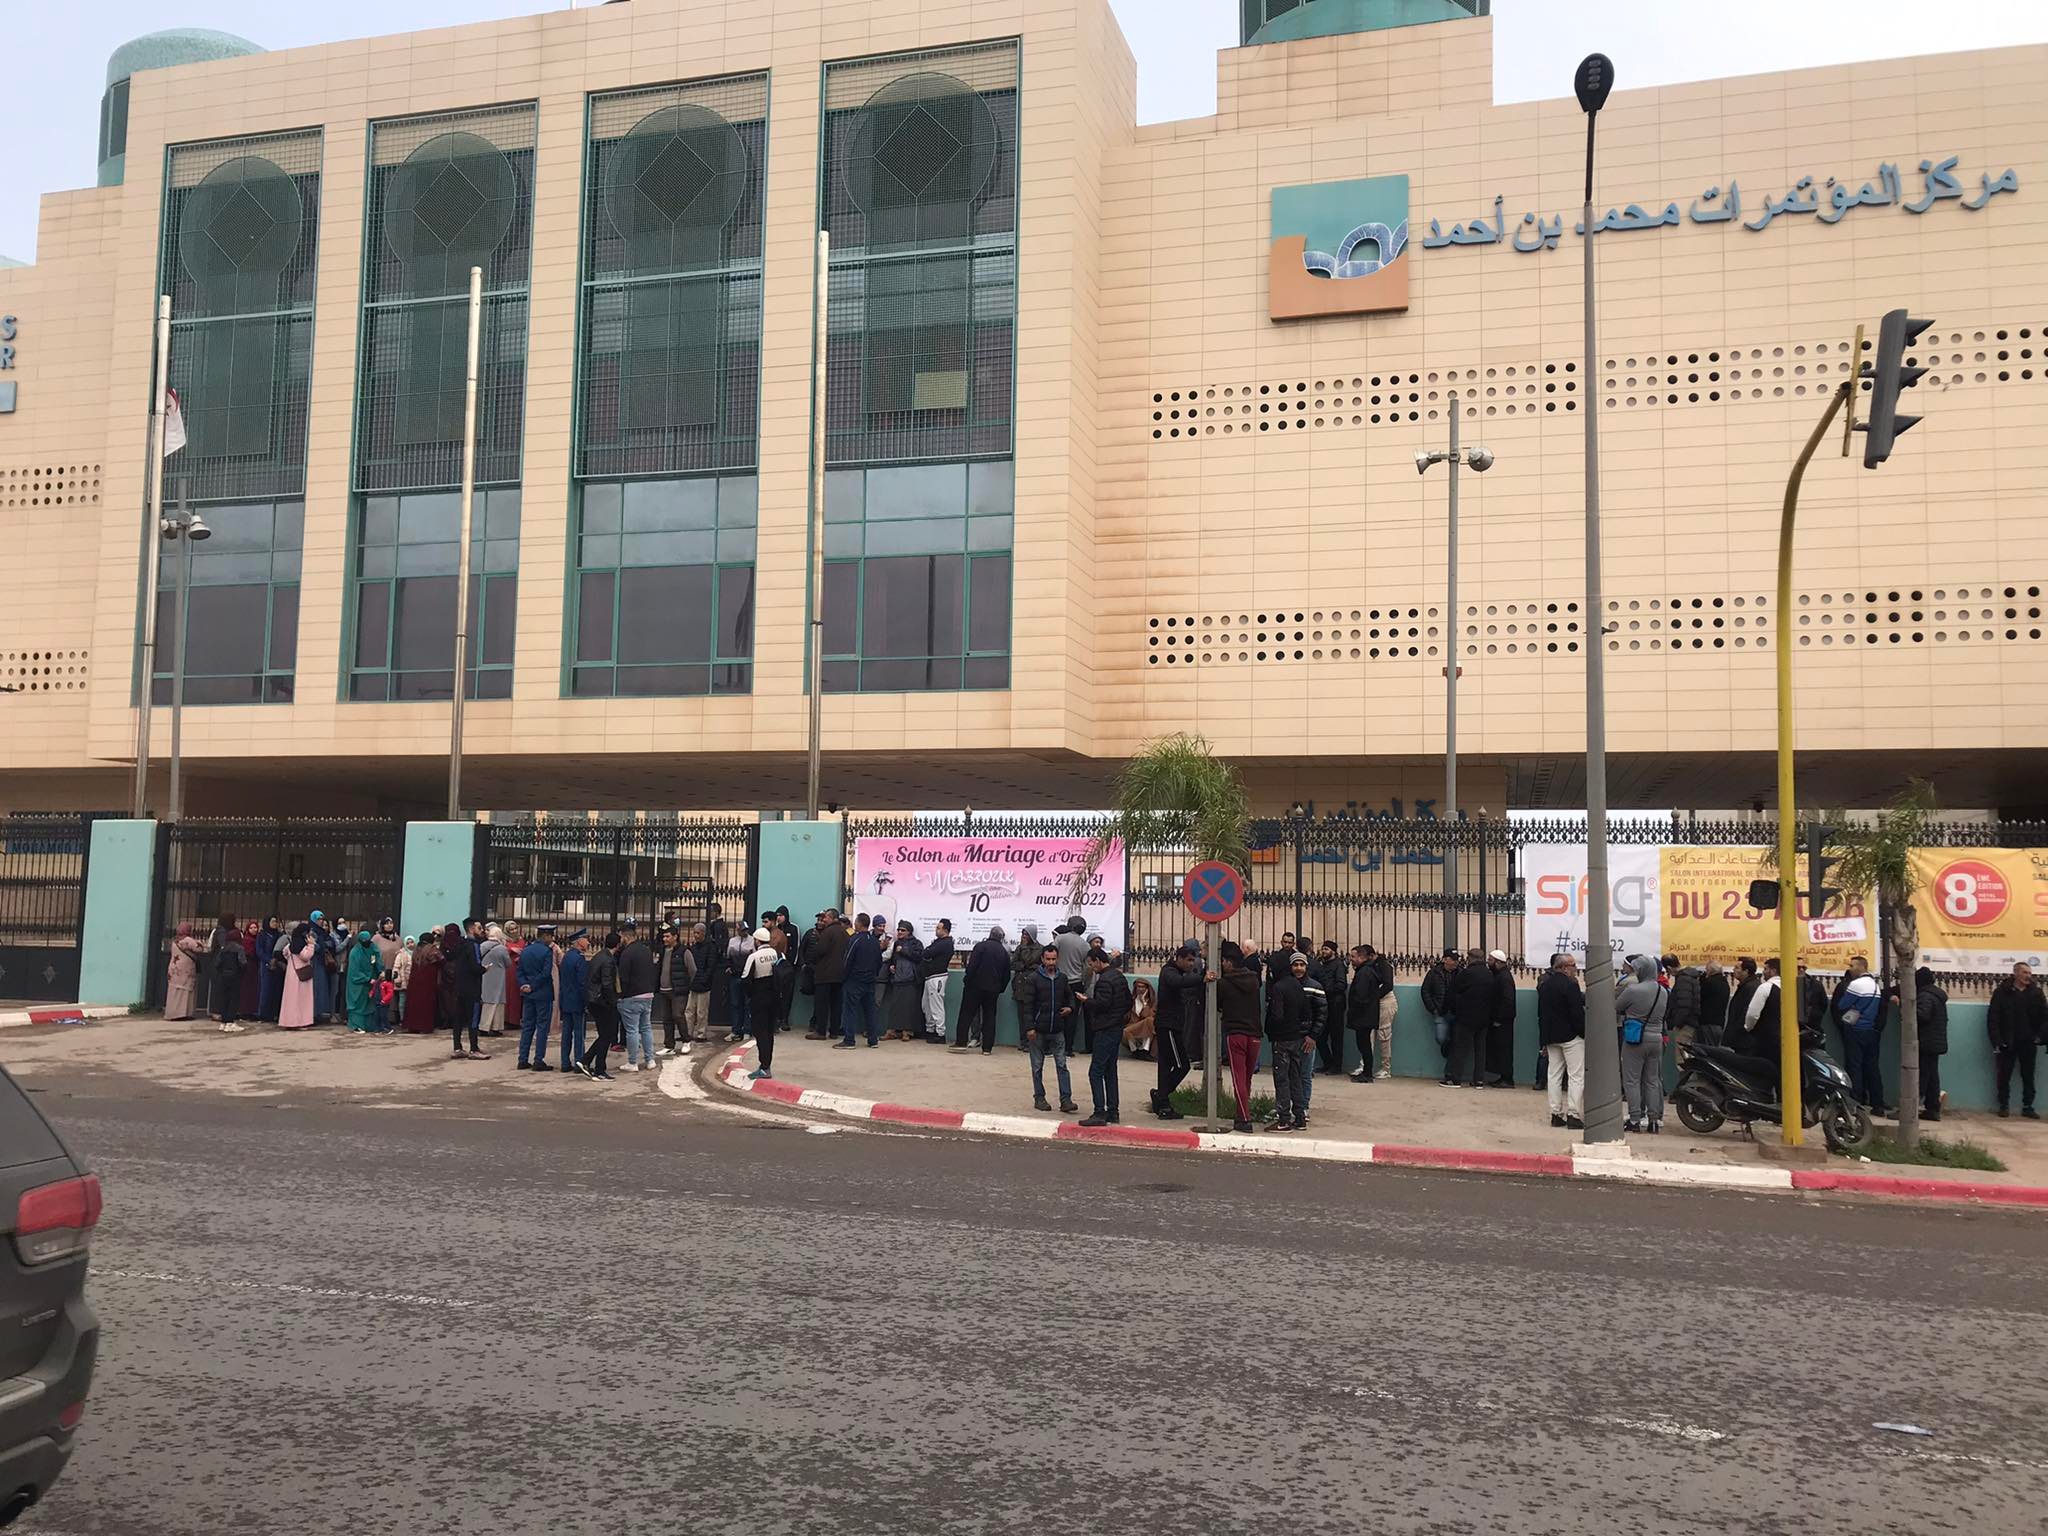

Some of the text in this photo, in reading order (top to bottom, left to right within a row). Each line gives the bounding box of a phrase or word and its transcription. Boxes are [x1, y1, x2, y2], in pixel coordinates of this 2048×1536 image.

[1689, 159, 1902, 231] المؤتمرات
[1902, 155, 2018, 213] مركز
[1423, 193, 1505, 249] أحمد
[1513, 212, 1562, 253] بن
[882, 843, 1091, 869] Le Salon du Mariage d'Ora
[1039, 873, 1104, 886] du 24 31
[969, 892, 990, 913] 10
[1035, 895, 1071, 906] mars
[1669, 891, 1710, 920] DU
[1944, 873, 1978, 918] 8
[1555, 931, 1625, 953] #sia22
[1813, 923, 1827, 941] 8
